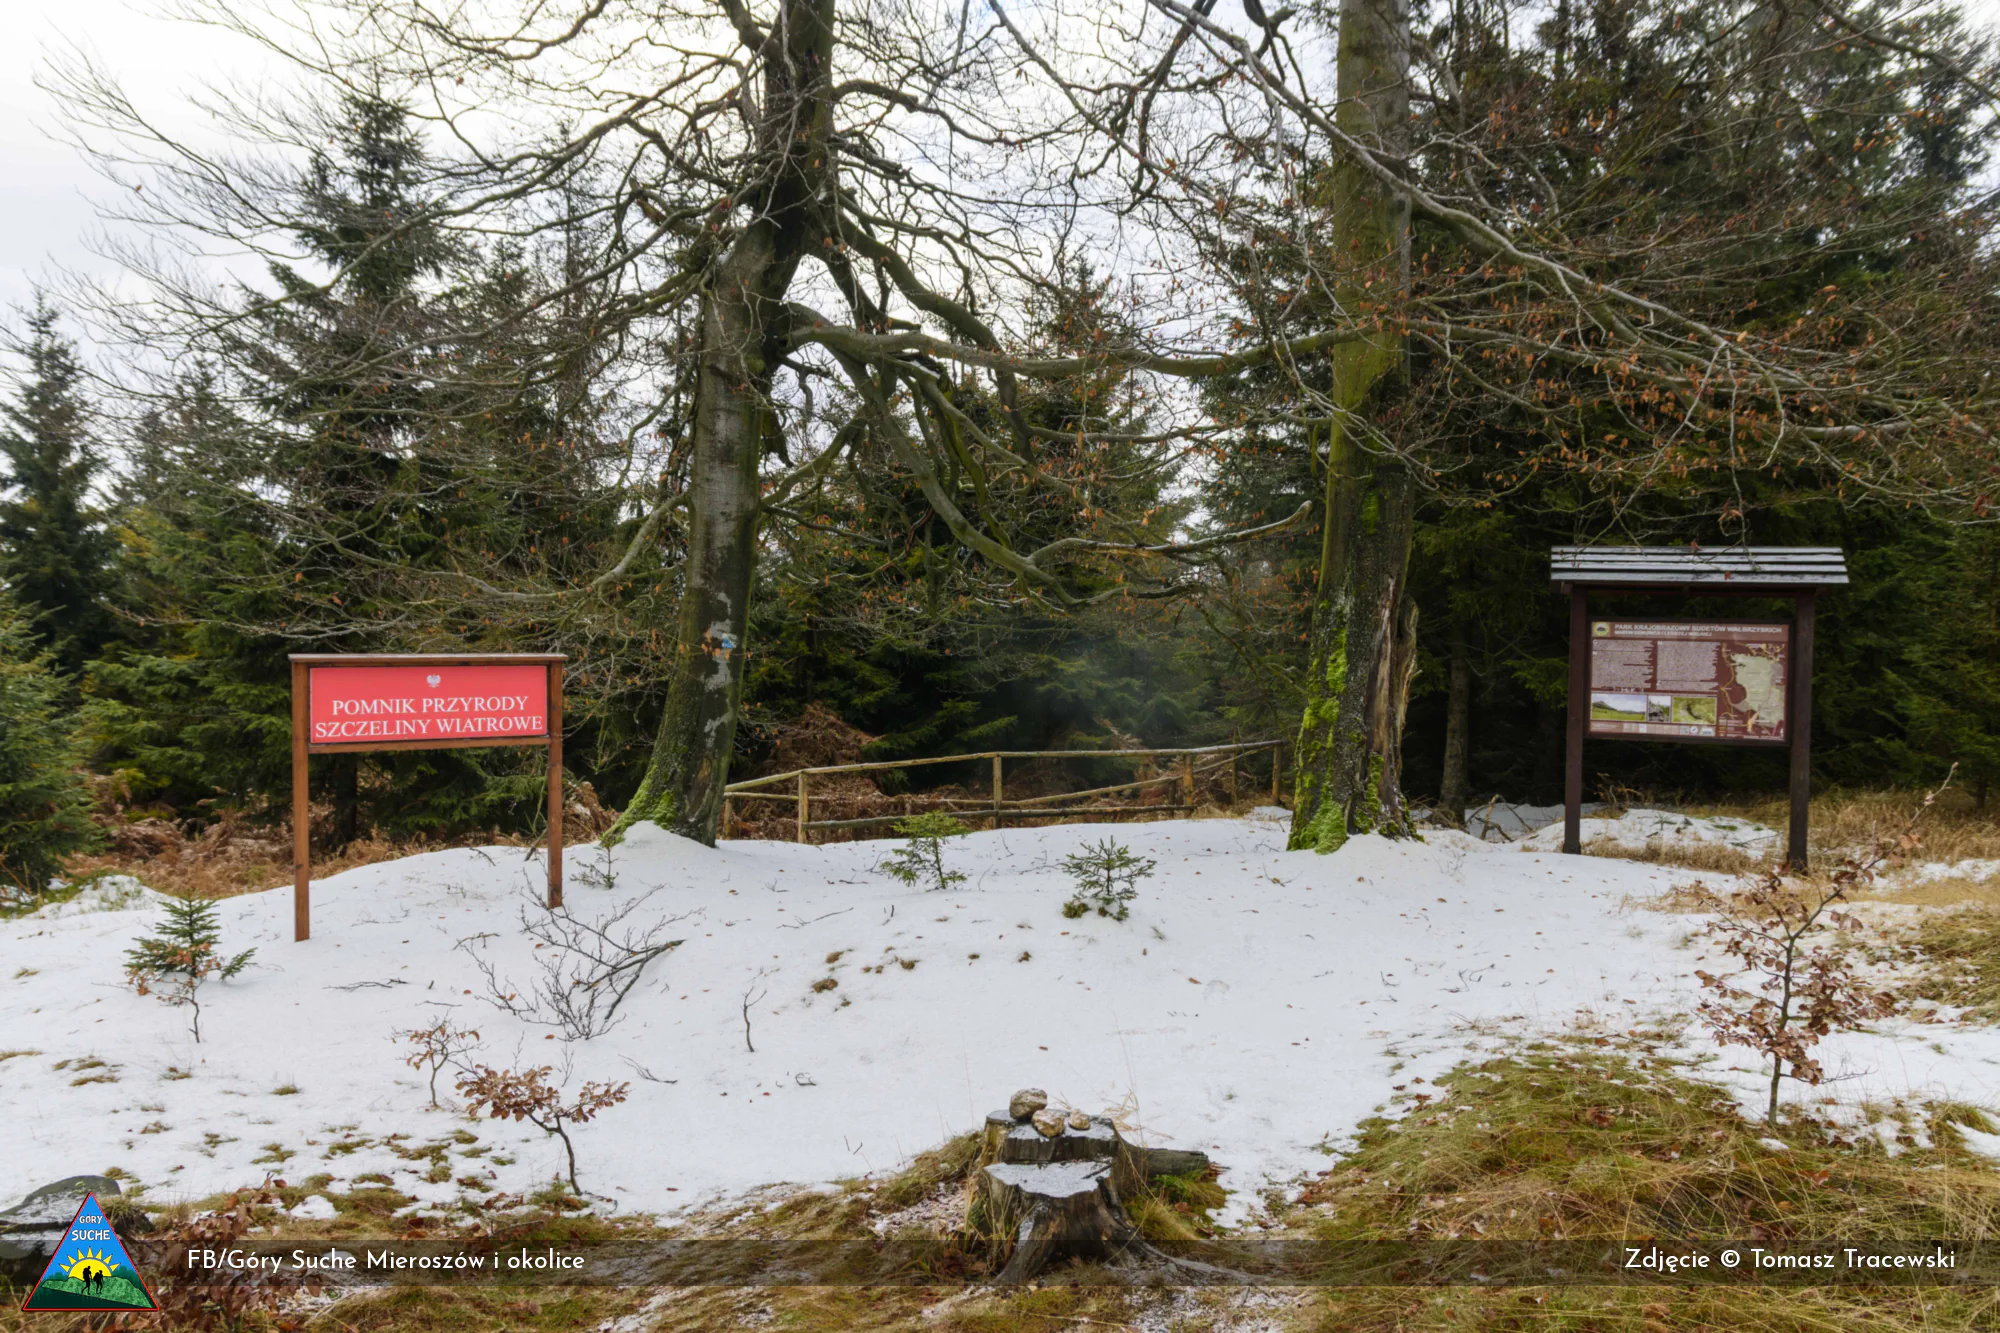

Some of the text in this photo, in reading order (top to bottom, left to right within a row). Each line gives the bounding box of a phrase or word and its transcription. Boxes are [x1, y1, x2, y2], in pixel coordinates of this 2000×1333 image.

[332, 696, 529, 716] POMNIK PRZYRODY
[315, 716, 543, 738] SZCZELINY WIATROWE
